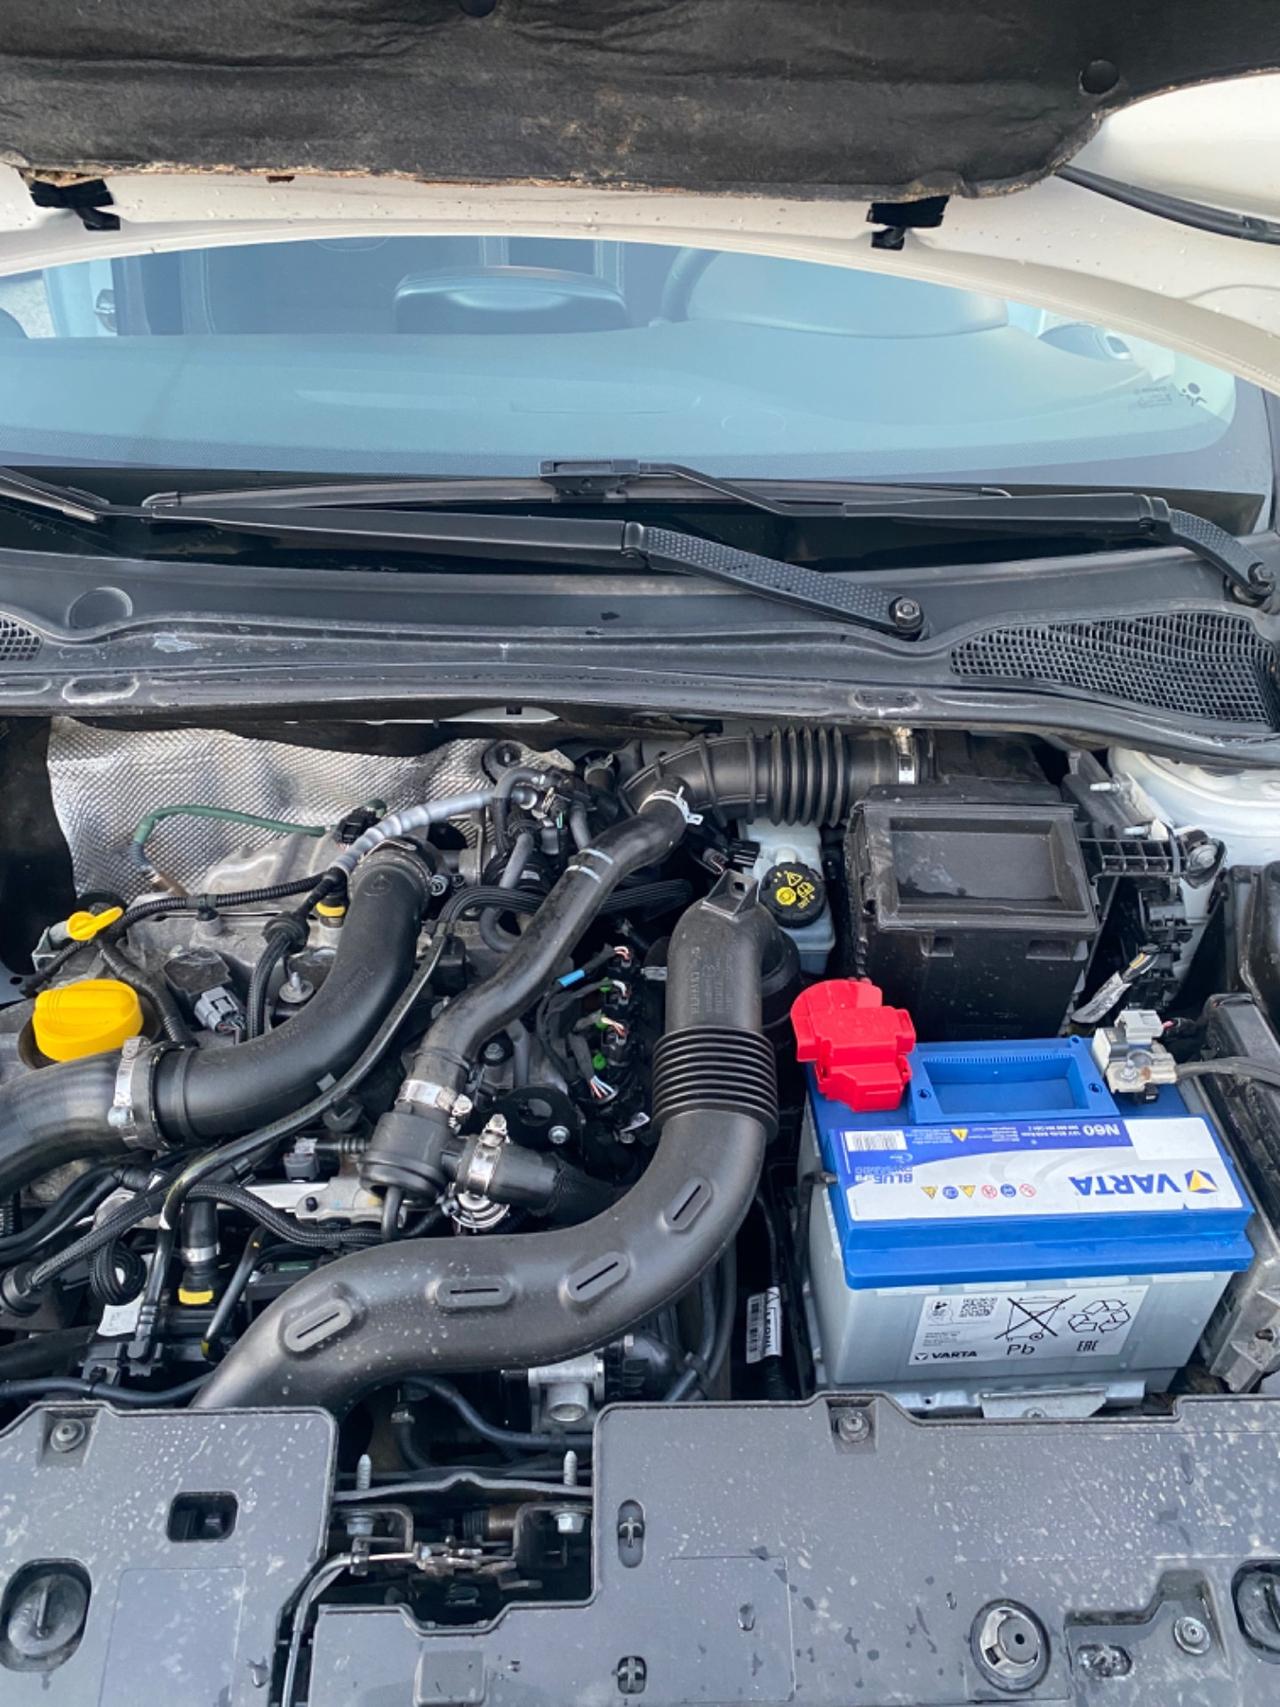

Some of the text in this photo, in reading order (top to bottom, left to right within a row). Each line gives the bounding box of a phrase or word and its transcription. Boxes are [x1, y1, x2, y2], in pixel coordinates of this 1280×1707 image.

[1083, 1124, 1120, 1136] N60
[874, 1173, 913, 1184] BLUE
[1068, 1173, 1182, 1196] VARTA
[932, 1350, 978, 1359] VARTA
[1007, 1343, 1036, 1356] Pb
